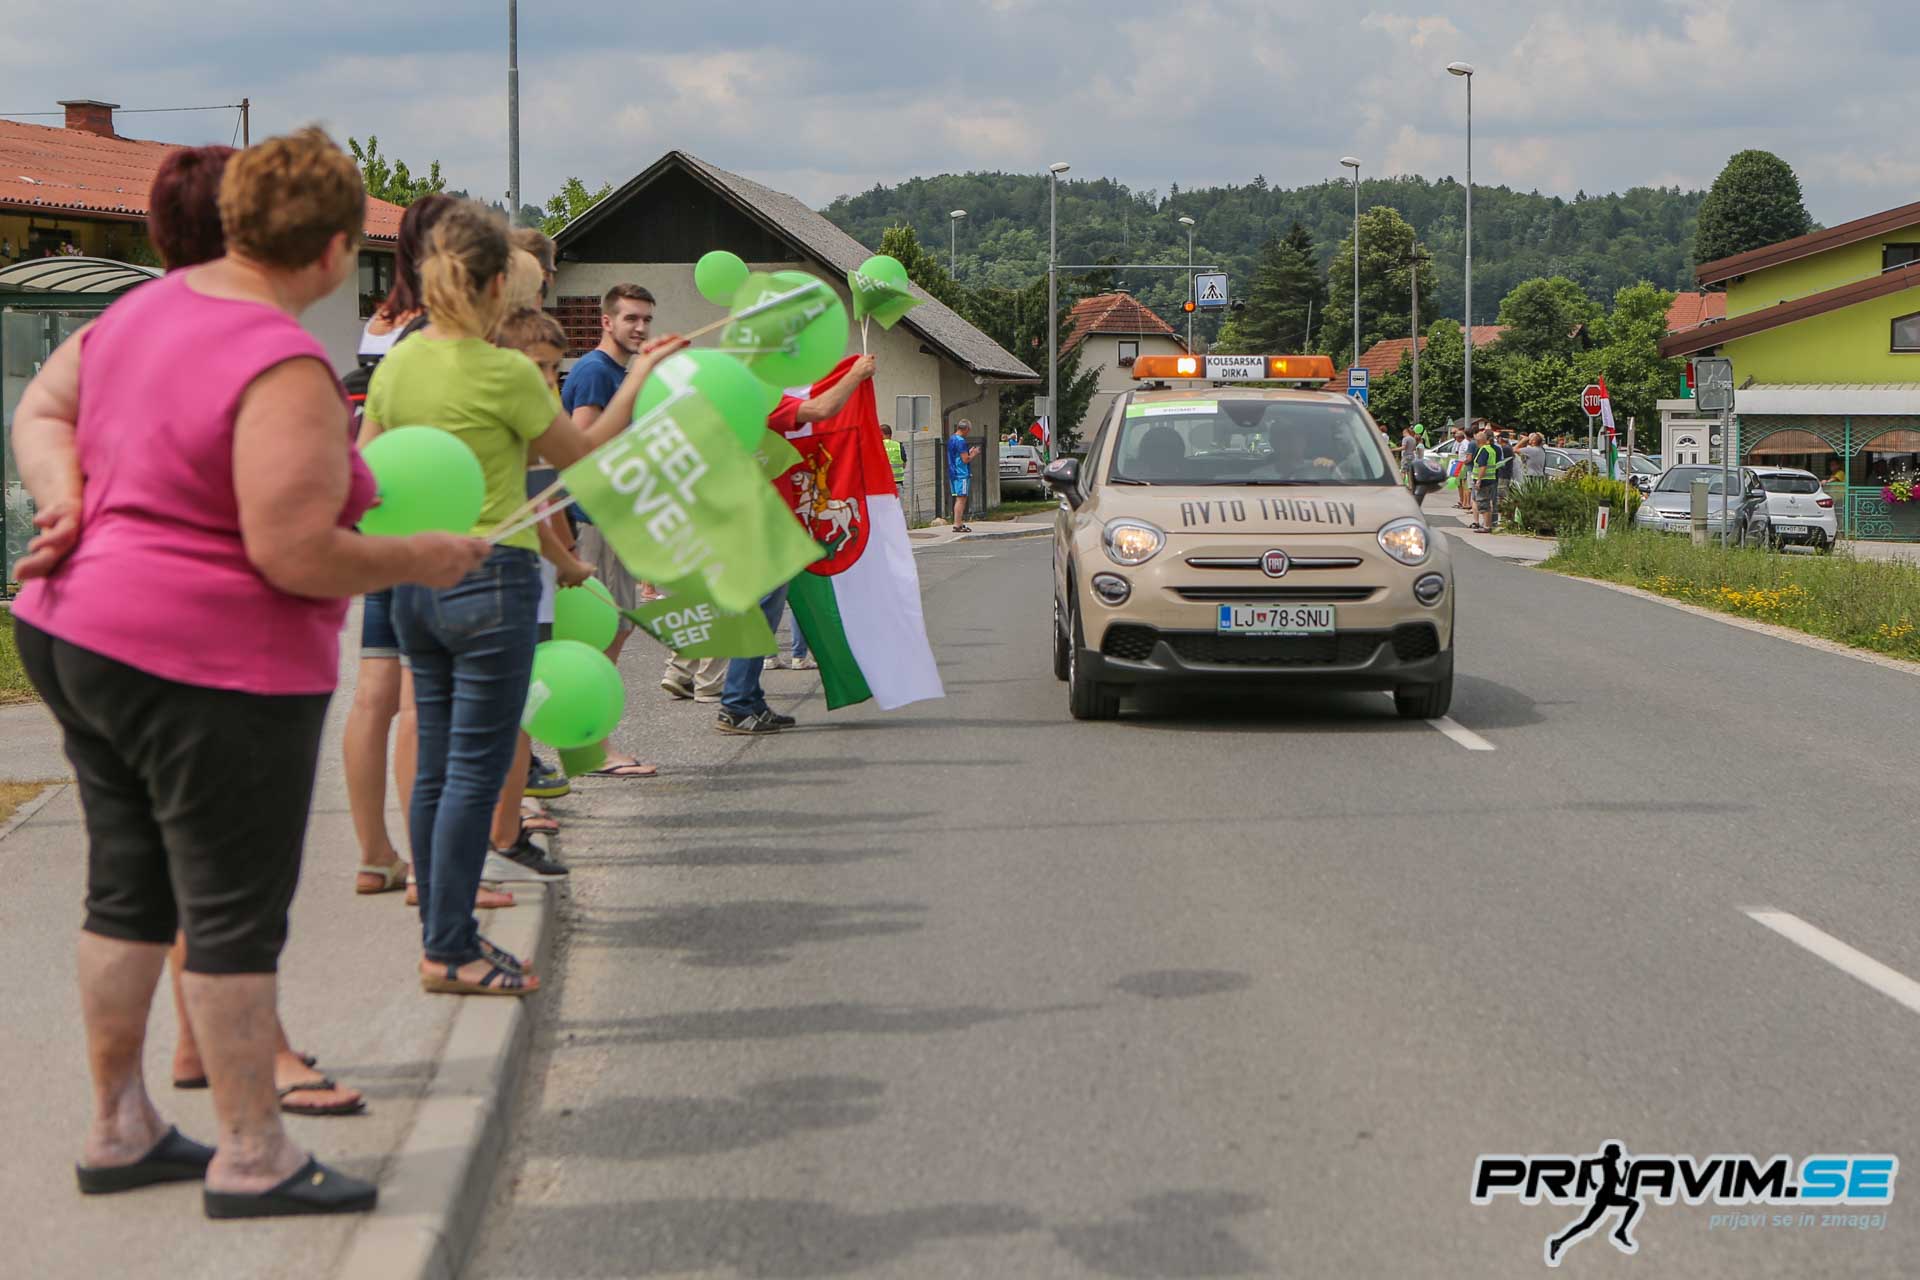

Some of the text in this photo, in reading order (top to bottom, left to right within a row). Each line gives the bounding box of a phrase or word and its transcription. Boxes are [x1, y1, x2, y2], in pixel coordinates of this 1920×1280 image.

[1207, 357, 1263, 366] KOLESARSKA
[1221, 368, 1249, 378] DIRKA
[638, 416, 710, 504] FEEL
[1180, 498, 1356, 527] AVTO TRIGLAV
[1267, 556, 1285, 571] FIAT
[1234, 609, 1330, 628] LJ 78-SNU
